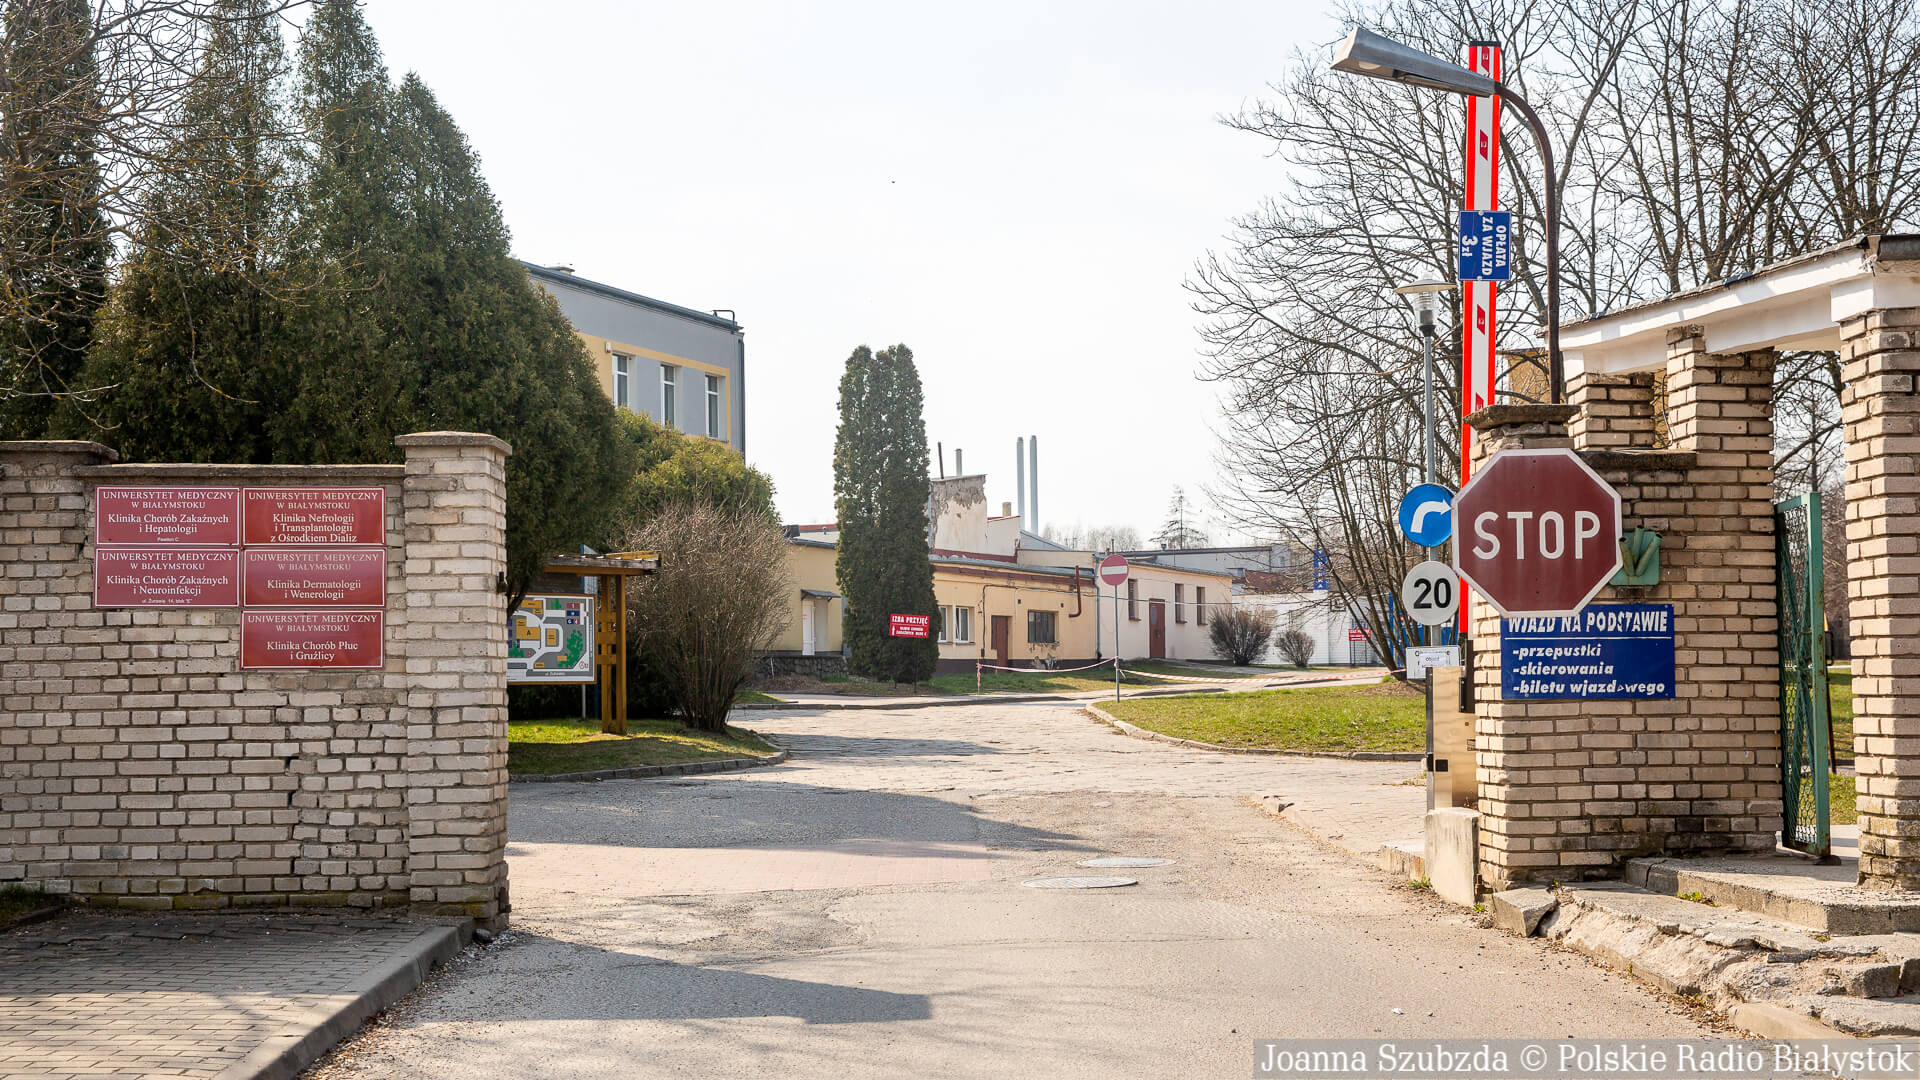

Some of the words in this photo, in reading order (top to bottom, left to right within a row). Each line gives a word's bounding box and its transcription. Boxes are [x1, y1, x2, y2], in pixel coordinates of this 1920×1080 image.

[1482, 217, 1493, 232] ZA
[1496, 225, 1507, 267] OPŁATA
[1482, 236, 1493, 275] WJAZD
[108, 514, 140, 522] Klinika
[144, 514, 177, 522] Chorób
[180, 514, 228, 525] Zakaźnych
[273, 514, 305, 522] Klinika
[309, 514, 354, 524] Nefrologii
[145, 525, 197, 534] Hepatologii
[280, 524, 352, 533] Transplantologii
[278, 534, 327, 542] Ośrodkiem
[330, 534, 357, 542] Dializ
[1472, 510, 1600, 560] STOP
[107, 576, 140, 584] Klinika
[143, 576, 176, 584] Chorób
[179, 576, 228, 586] Zakaźnych
[267, 580, 300, 588] Klinika
[303, 580, 361, 590] Dermatologii
[140, 586, 200, 596] Neuroinfekcji
[290, 590, 344, 600] Wenerologii
[1413, 578, 1451, 609] 20
[1508, 616, 1556, 633] WJAZD
[1560, 614, 1581, 632] NA
[1586, 611, 1668, 632] PODSTAWIE
[267, 642, 300, 650] Klinika
[303, 642, 335, 650] Chorób
[338, 642, 358, 650] Płuc
[296, 651, 334, 662] Gruźlicy
[1512, 644, 1601, 660] -przepustki
[1512, 662, 1614, 675] -skierowania
[1512, 680, 1565, 694] -biletu
